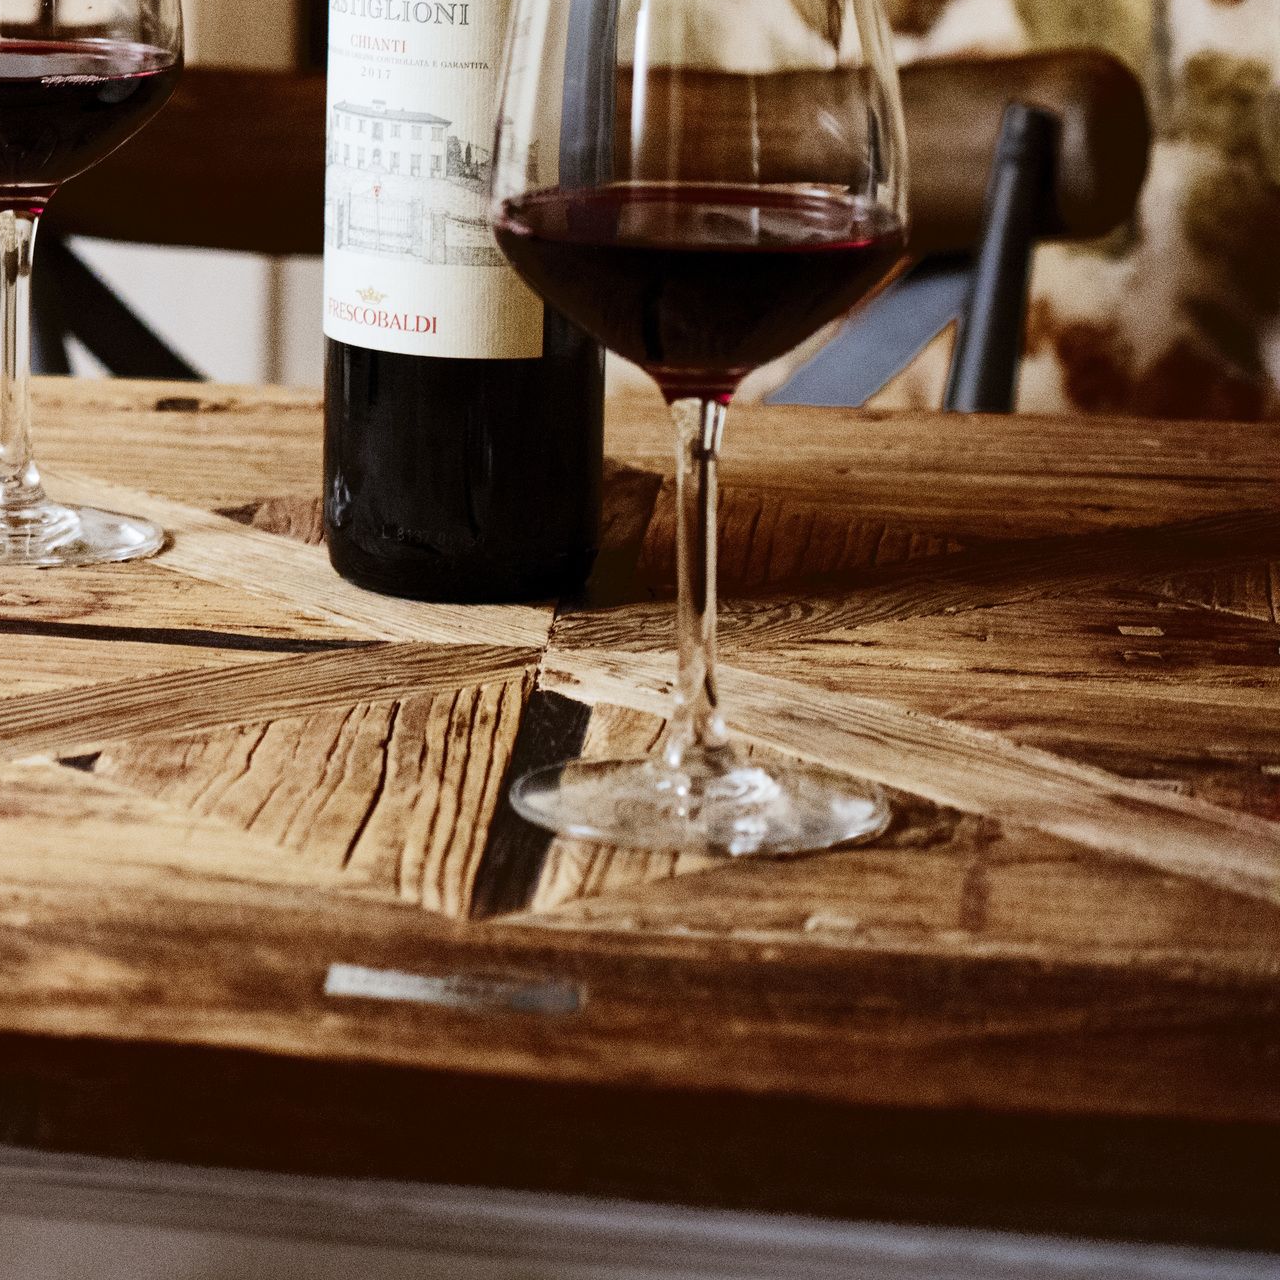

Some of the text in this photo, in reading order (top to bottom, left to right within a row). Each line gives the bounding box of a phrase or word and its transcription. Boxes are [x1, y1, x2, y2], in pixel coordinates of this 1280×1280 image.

[350, 33, 408, 54] CHIANTI
[360, 66, 393, 81] 2017
[440, 60, 490, 70] GARANTITA
[328, 297, 438, 334] FRESCOBALDI
